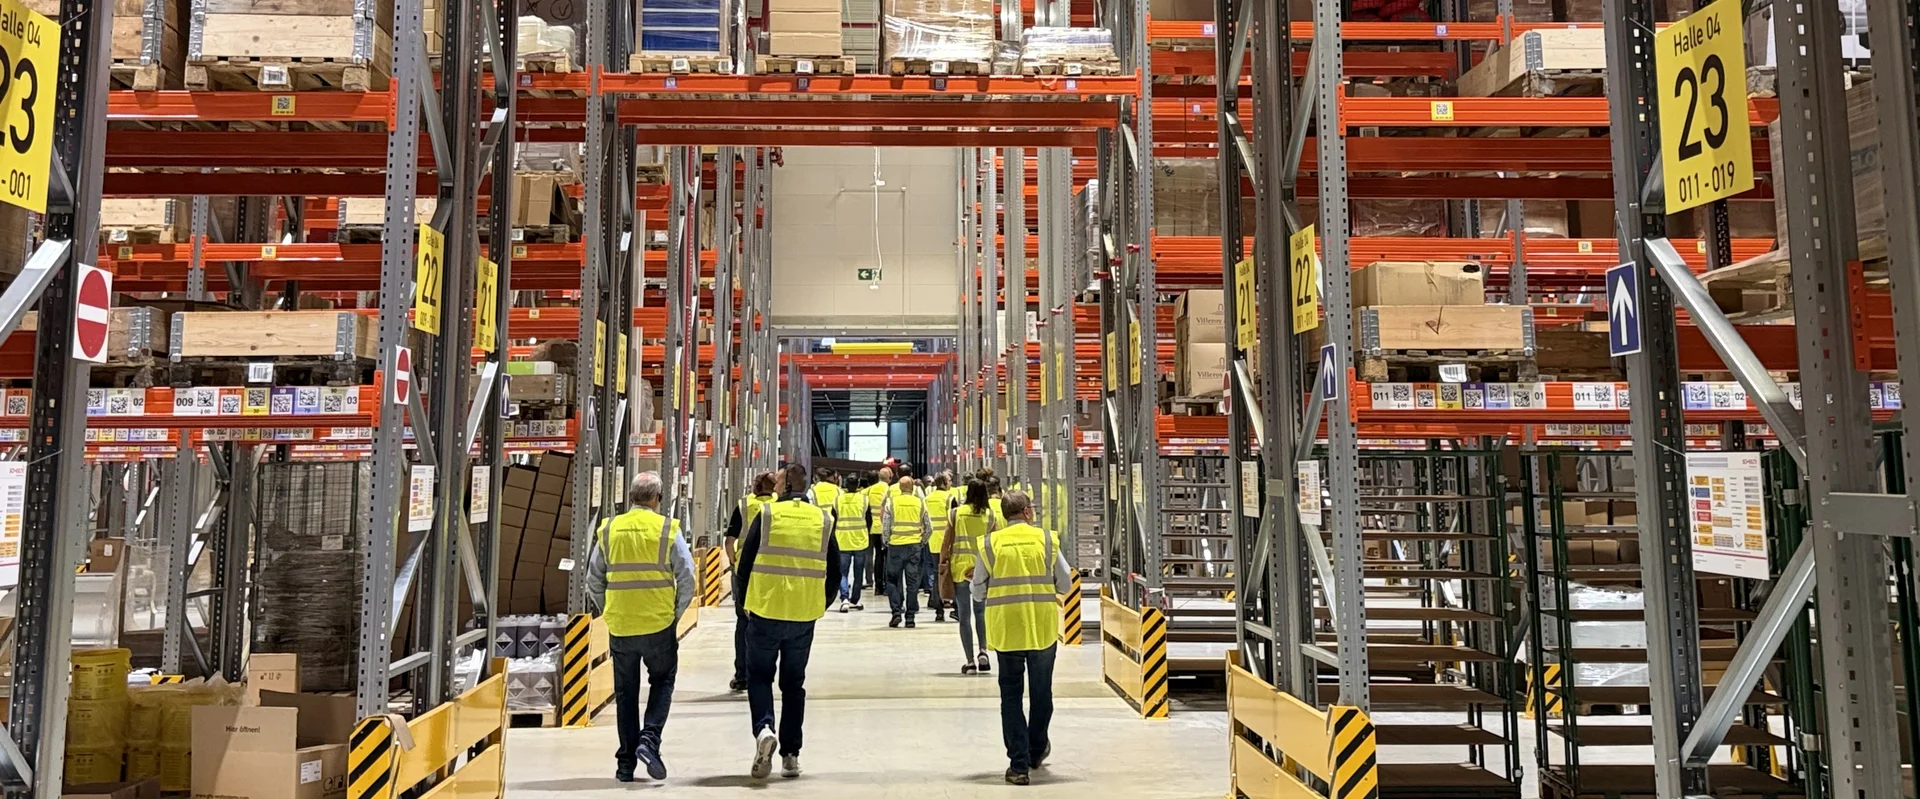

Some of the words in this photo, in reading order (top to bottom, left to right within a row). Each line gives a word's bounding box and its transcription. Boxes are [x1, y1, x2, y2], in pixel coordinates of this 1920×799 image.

[0, 4, 24, 39] alle
[27, 20, 41, 48] 04
[1673, 25, 1704, 57] Halle
[1706, 12, 1721, 41] 04
[1674, 54, 1729, 162] 23
[9, 168, 32, 201] 001
[1679, 172, 1700, 203] 011
[1711, 160, 1735, 193] 019
[421, 252, 439, 308] 22
[1295, 253, 1312, 308] 22
[480, 280, 492, 328] 21
[1239, 280, 1251, 326] 21
[133, 397, 144, 407] 02
[176, 397, 194, 407] 009
[346, 396, 358, 405] 03
[1373, 391, 1389, 401] 011
[1534, 391, 1544, 400] 01
[1574, 392, 1591, 401] 011
[1734, 392, 1745, 401] 02
[225, 725, 239, 733] Hier
